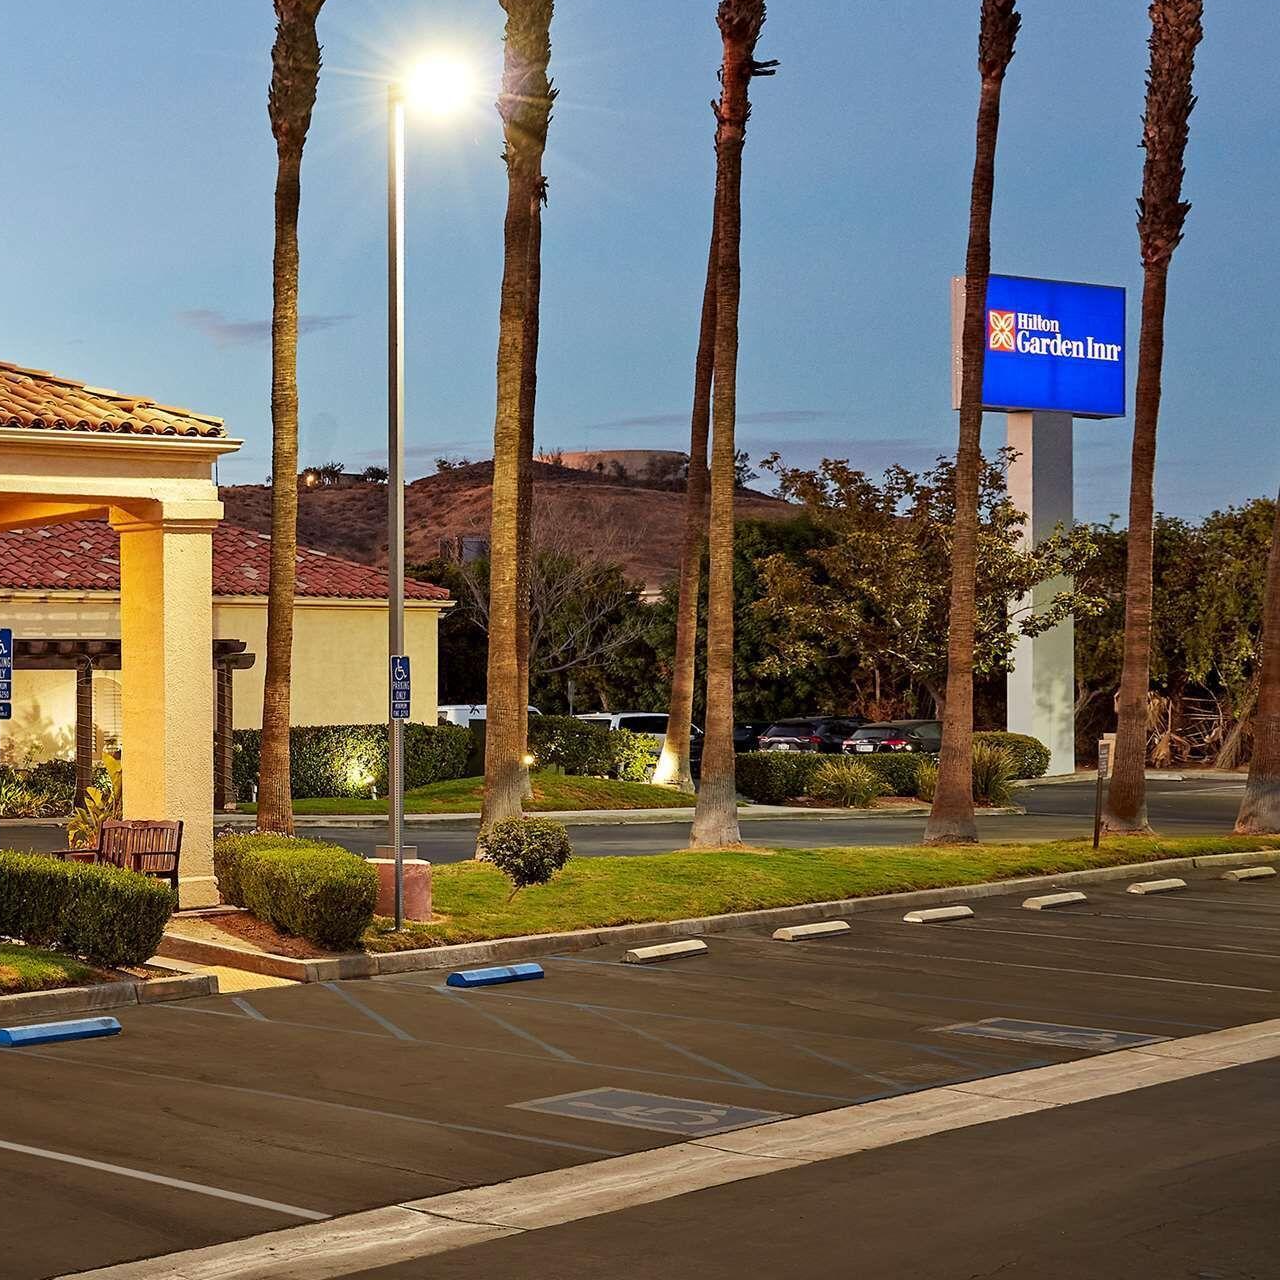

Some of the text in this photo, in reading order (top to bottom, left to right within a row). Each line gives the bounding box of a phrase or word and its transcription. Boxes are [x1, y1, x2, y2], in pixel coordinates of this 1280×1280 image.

[1017, 312, 1059, 332] Hilton
[1016, 330, 1120, 361] Garden Inn
